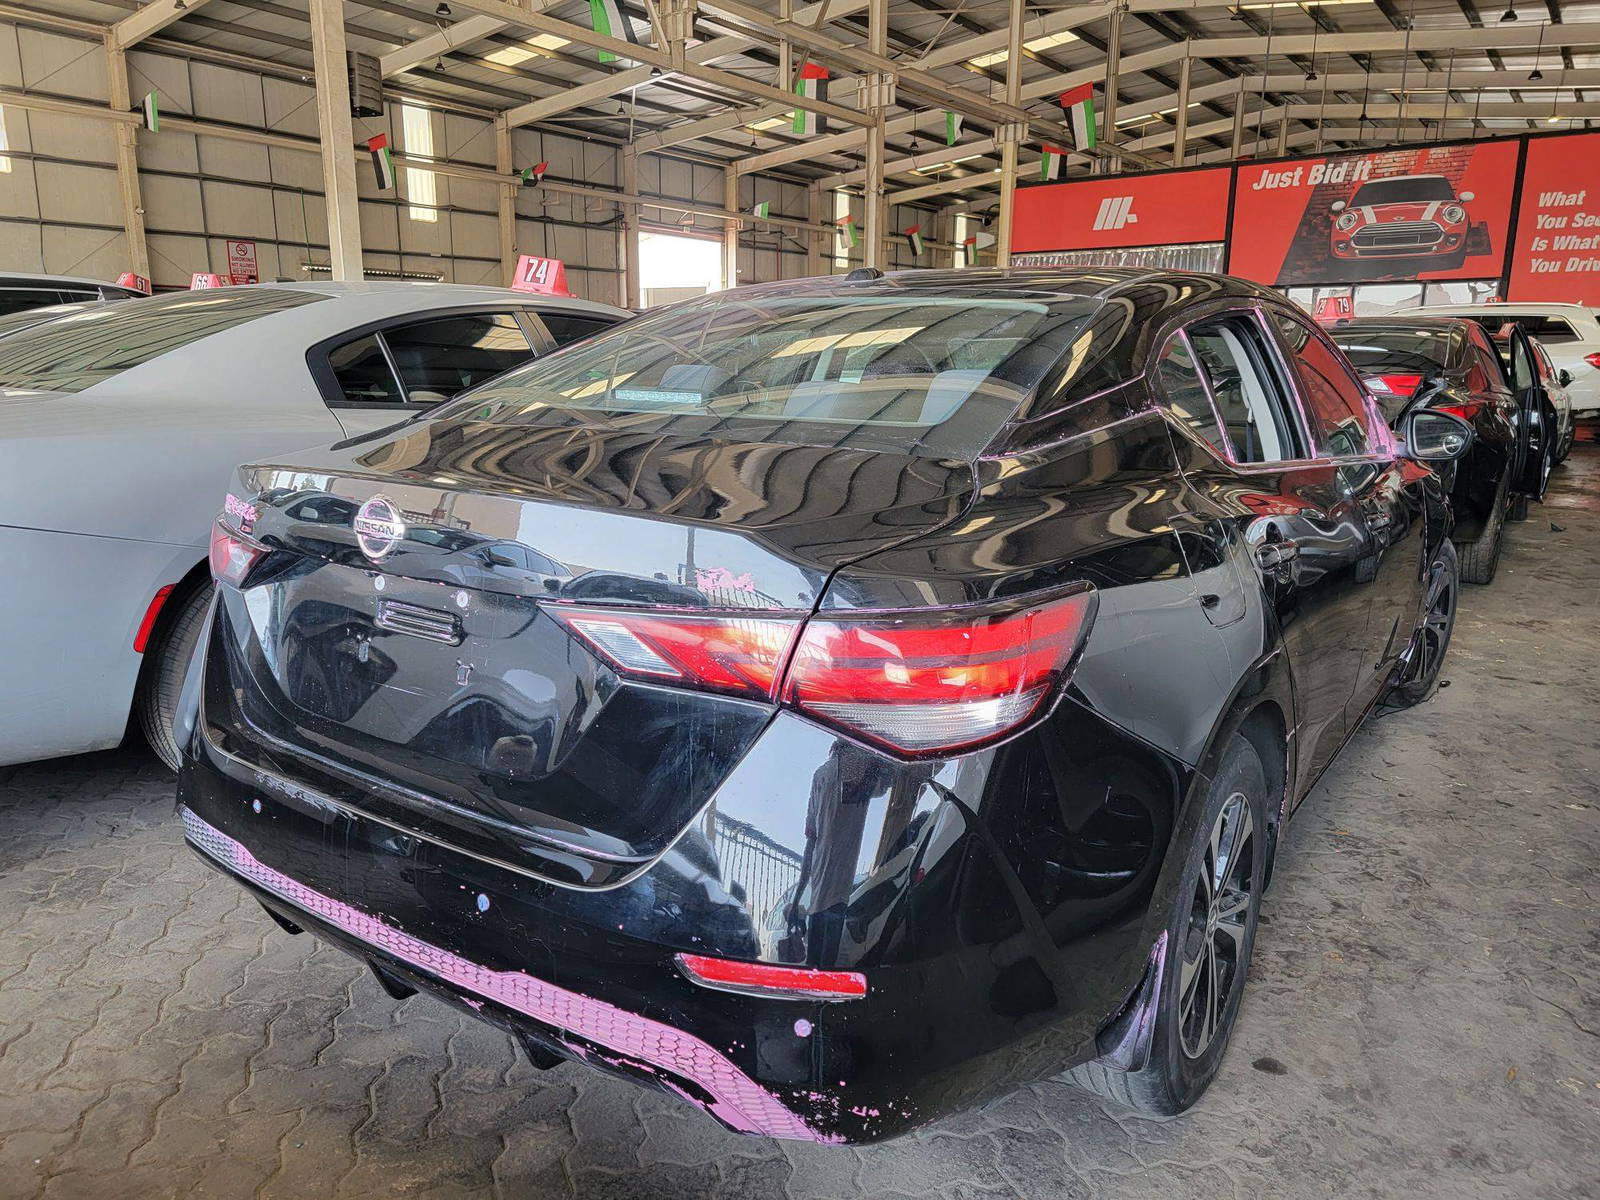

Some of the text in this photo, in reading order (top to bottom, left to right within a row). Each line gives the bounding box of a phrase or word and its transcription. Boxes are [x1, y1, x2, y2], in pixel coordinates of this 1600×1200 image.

[1253, 159, 1373, 190] Just Bid It
[1538, 190, 1586, 207] What
[1536, 214, 1568, 230] You
[1531, 234, 1600, 251] Is What
[524, 258, 550, 284] 74
[1530, 258, 1562, 273] You
[136, 277, 146, 291] 61
[195, 275, 208, 290] 66
[1337, 298, 1350, 313] 79
[358, 519, 395, 536] NISSAN
